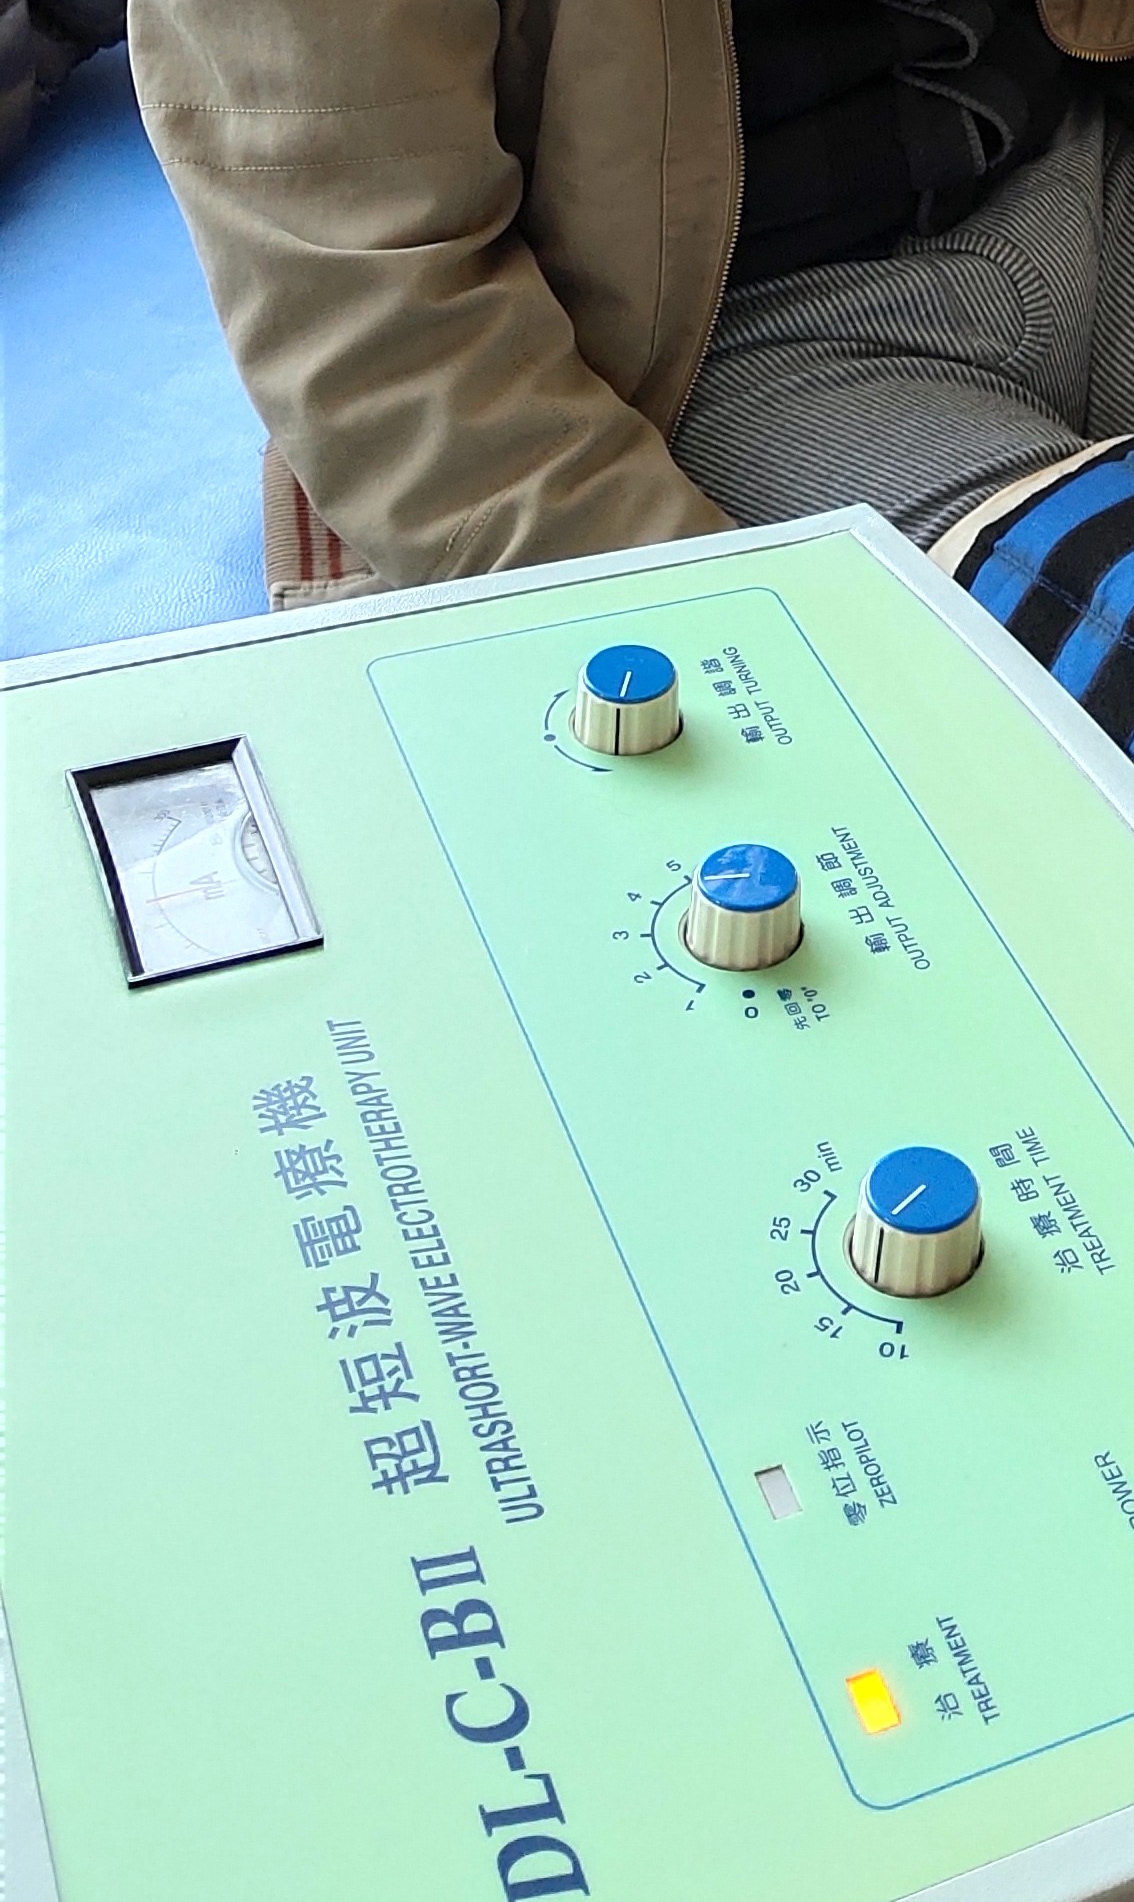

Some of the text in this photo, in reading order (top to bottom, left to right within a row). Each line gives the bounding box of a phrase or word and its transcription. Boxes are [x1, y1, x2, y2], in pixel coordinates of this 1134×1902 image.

[723, 647, 793, 745] OUTPUT TURNING
[666, 859, 682, 872] 5
[627, 891, 642, 902] 4
[831, 826, 930, 970] OUTPUT ADJUSTMENT
[612, 930, 630, 940] 3
[633, 971, 652, 984] 2
[685, 999, 695, 1011] 1
[811, 1003, 830, 1022] TO
[792, 1141, 843, 1193] 30 min
[1015, 1126, 1115, 1276] TREATMENT TIME
[769, 1216, 792, 1242] 25
[326, 1018, 546, 1525] ULTRASHORT-WAVE ELECTROTHERAPY UNIT
[774, 1269, 801, 1296] 20
[252, 1075, 450, 1497] 超短波電療機
[813, 1315, 844, 1341] 15
[878, 1341, 910, 1360] 10
[841, 1419, 898, 1509] ZEROPILOT
[936, 1616, 1000, 1725] TREATMENT
